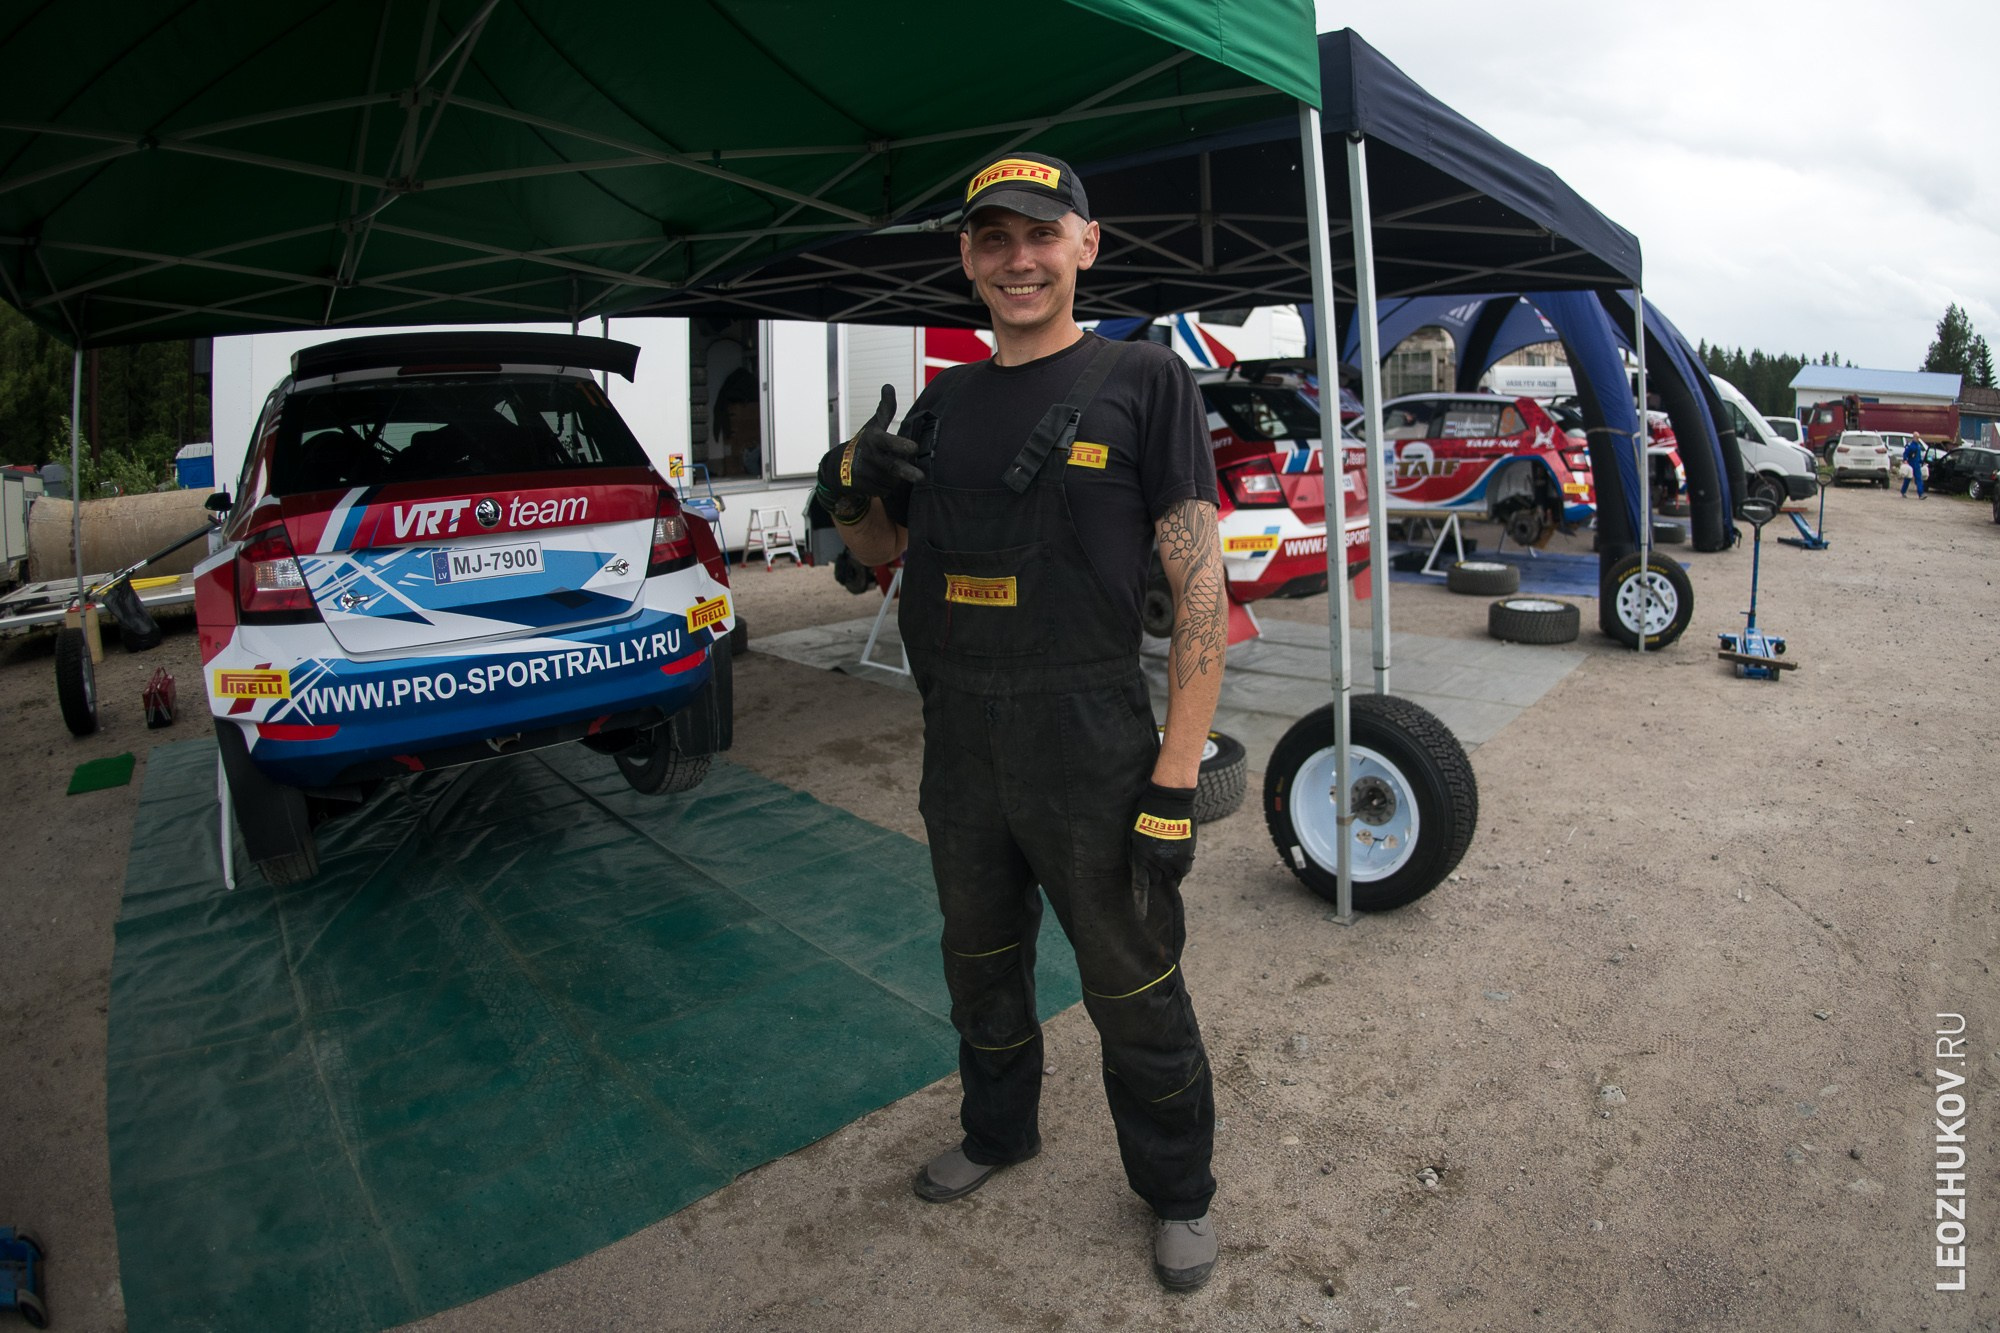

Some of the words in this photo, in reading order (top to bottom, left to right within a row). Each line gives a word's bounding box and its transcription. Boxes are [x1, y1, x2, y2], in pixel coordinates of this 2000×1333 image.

[972, 164, 1051, 192] PIRELLI
[1396, 459, 1460, 476] TAIF
[393, 499, 471, 538] VRT
[509, 496, 588, 527] team
[438, 572, 447, 580] LV
[454, 548, 537, 576] MJ-7900
[692, 599, 726, 628] PIRELLI
[221, 673, 283, 695] PIRELLI
[303, 628, 681, 715] WWW.PRO-SPORTRALLY.RU
[1139, 817, 1187, 836] PIRELLI
